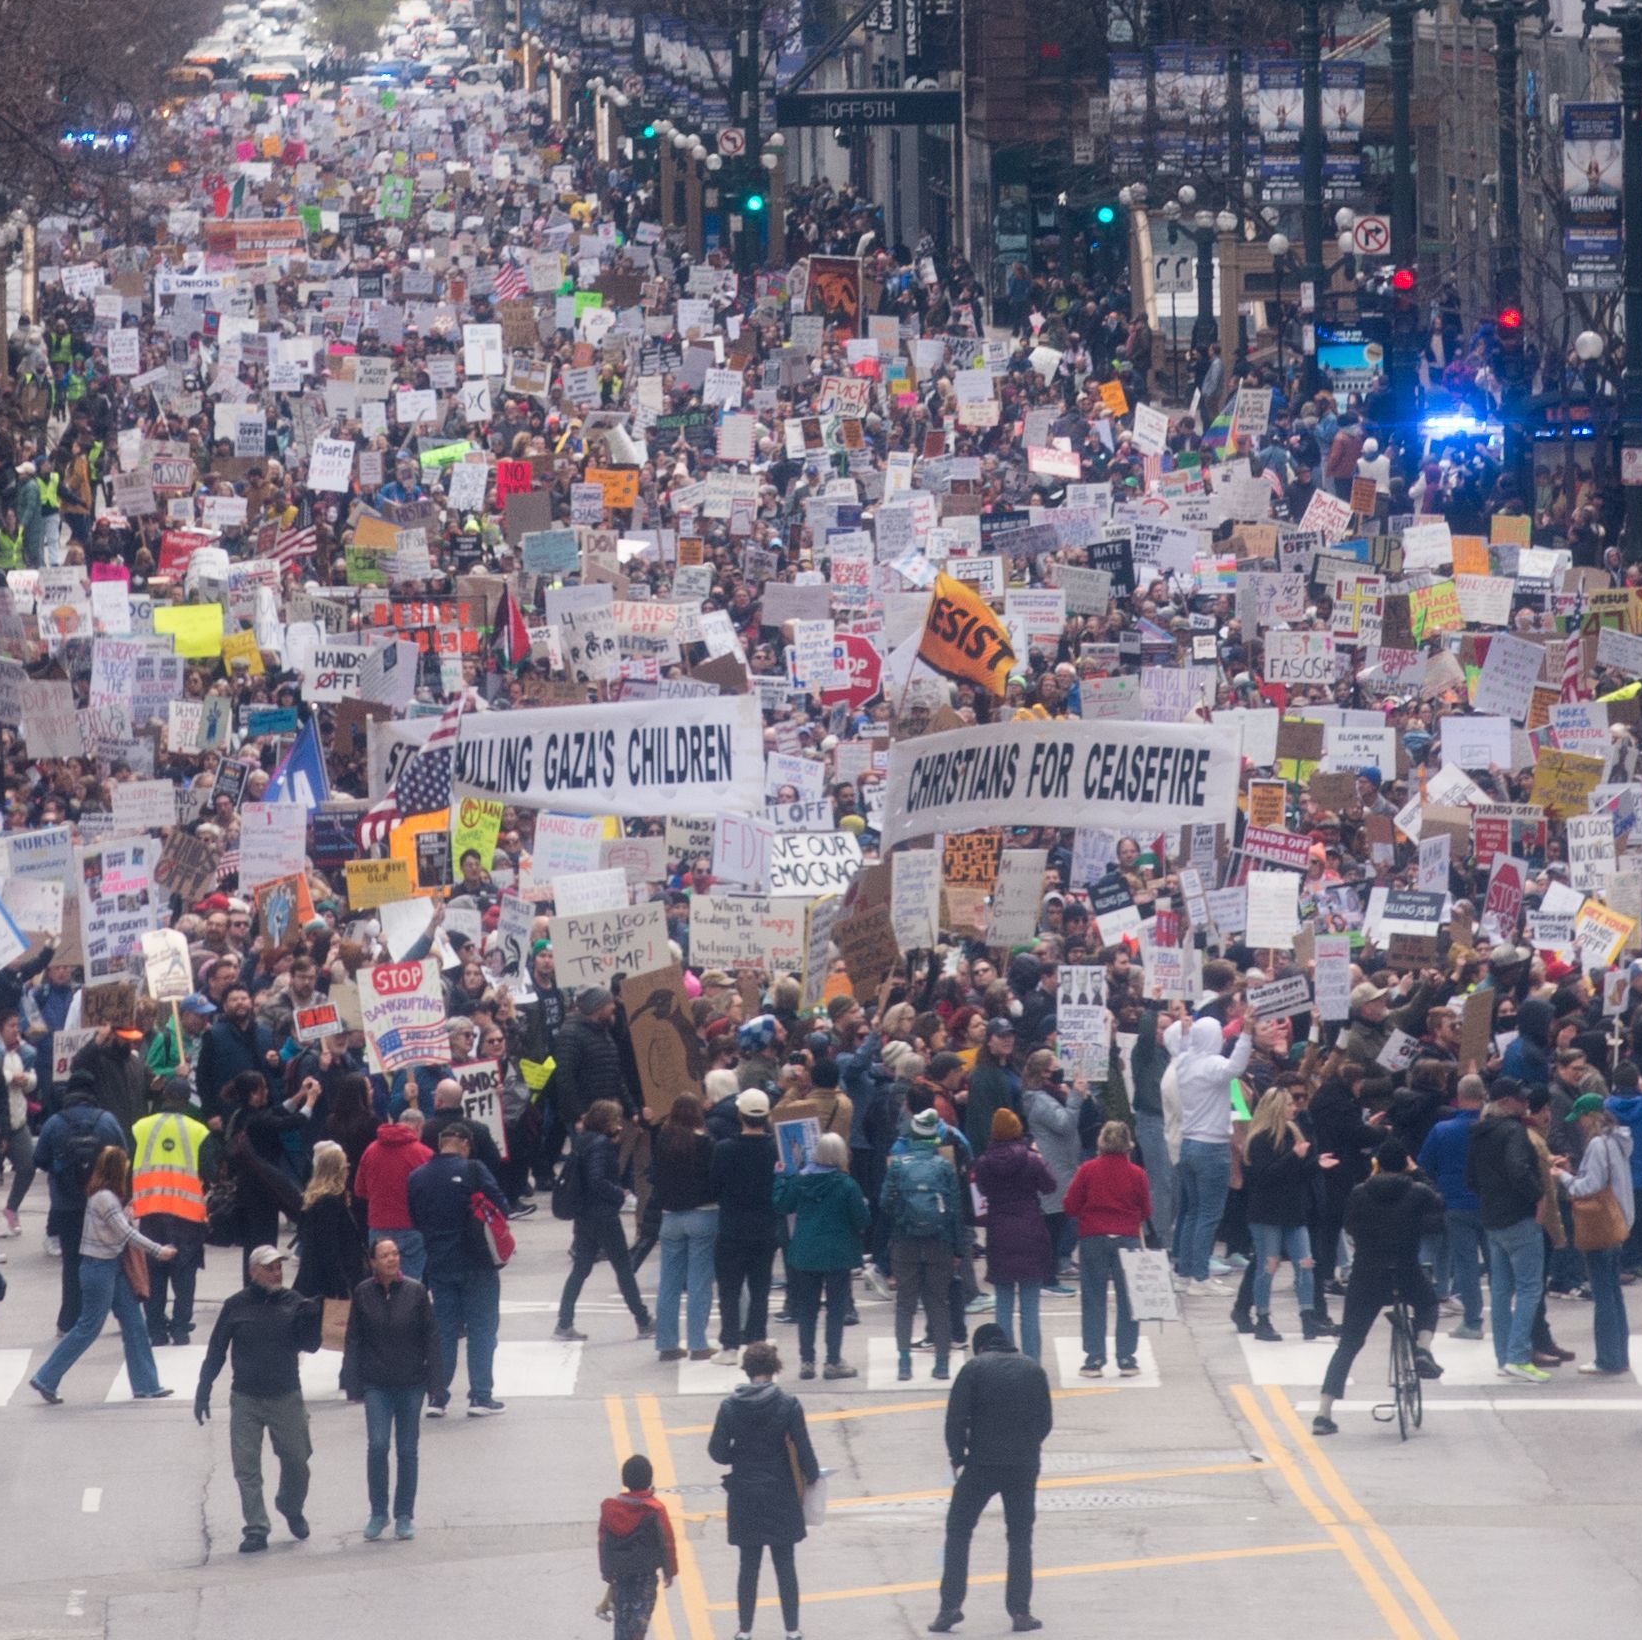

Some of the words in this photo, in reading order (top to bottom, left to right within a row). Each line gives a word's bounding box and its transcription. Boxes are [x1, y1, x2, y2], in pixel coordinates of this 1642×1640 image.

[175, 279, 220, 288] UNIONS
[821, 377, 869, 404] FUCK
[505, 463, 525, 482] NO
[1181, 512, 1208, 522] NAZI
[1282, 531, 1318, 541] HANDS
[1094, 544, 1122, 558] HATE
[1283, 540, 1318, 554] OFF!
[1590, 594, 1630, 605] JESUS
[613, 602, 678, 622] HANDS
[631, 622, 657, 634] OFF
[929, 597, 1015, 671] ESIST
[1376, 647, 1418, 665] HANDS
[1338, 733, 1361, 742] ELON
[1362, 733, 1385, 742] MUSK
[456, 735, 534, 794] KILLING
[543, 729, 615, 790] GAZA'S
[627, 723, 733, 787] CHILDREN
[906, 742, 1020, 814] CHRISTIANS
[1025, 741, 1074, 800] FOR
[1083, 742, 1211, 808] CEASEFIRE
[1478, 805, 1513, 815] HANDS
[538, 818, 575, 836] HANDS
[579, 822, 599, 838] OFF
[1570, 823, 1585, 838] NO
[1587, 821, 1613, 837] GODS
[12, 833, 68, 854] NURSES
[688, 835, 711, 846] OUR
[722, 818, 774, 875] FDT
[821, 835, 854, 856] OUR
[943, 835, 1003, 850] EXPECT
[1247, 830, 1286, 847] HANDS
[1288, 838, 1310, 851] OFF
[1245, 843, 1307, 864] PALESTINE
[1587, 843, 1614, 859] KINGS
[1487, 883, 1519, 909] STOP
[710, 899, 743, 912] When
[750, 900, 771, 914] did
[108, 917, 149, 934] STUDENTS
[567, 920, 596, 940] PUT
[601, 922, 612, 933] A
[616, 913, 660, 931] 100%
[736, 914, 753, 927] the
[759, 916, 795, 937] hungry
[1539, 924, 1567, 932] VOTING
[1584, 906, 1604, 921] GET
[1606, 916, 1632, 934] YOUR
[580, 929, 635, 951] TARIFF
[738, 932, 756, 941] or
[1539, 932, 1567, 940] RIGHTS
[1584, 920, 1615, 943] HANDS
[567, 942, 654, 978] TRUMP!
[696, 939, 742, 958] helping
[746, 942, 766, 955] the
[771, 946, 799, 961] poor
[375, 965, 422, 992] STOP
[1250, 987, 1282, 1001] HANDS
[1283, 980, 1303, 992] OFF!
[364, 994, 444, 1023] BANKRUPTING
[391, 1013, 413, 1025] the
